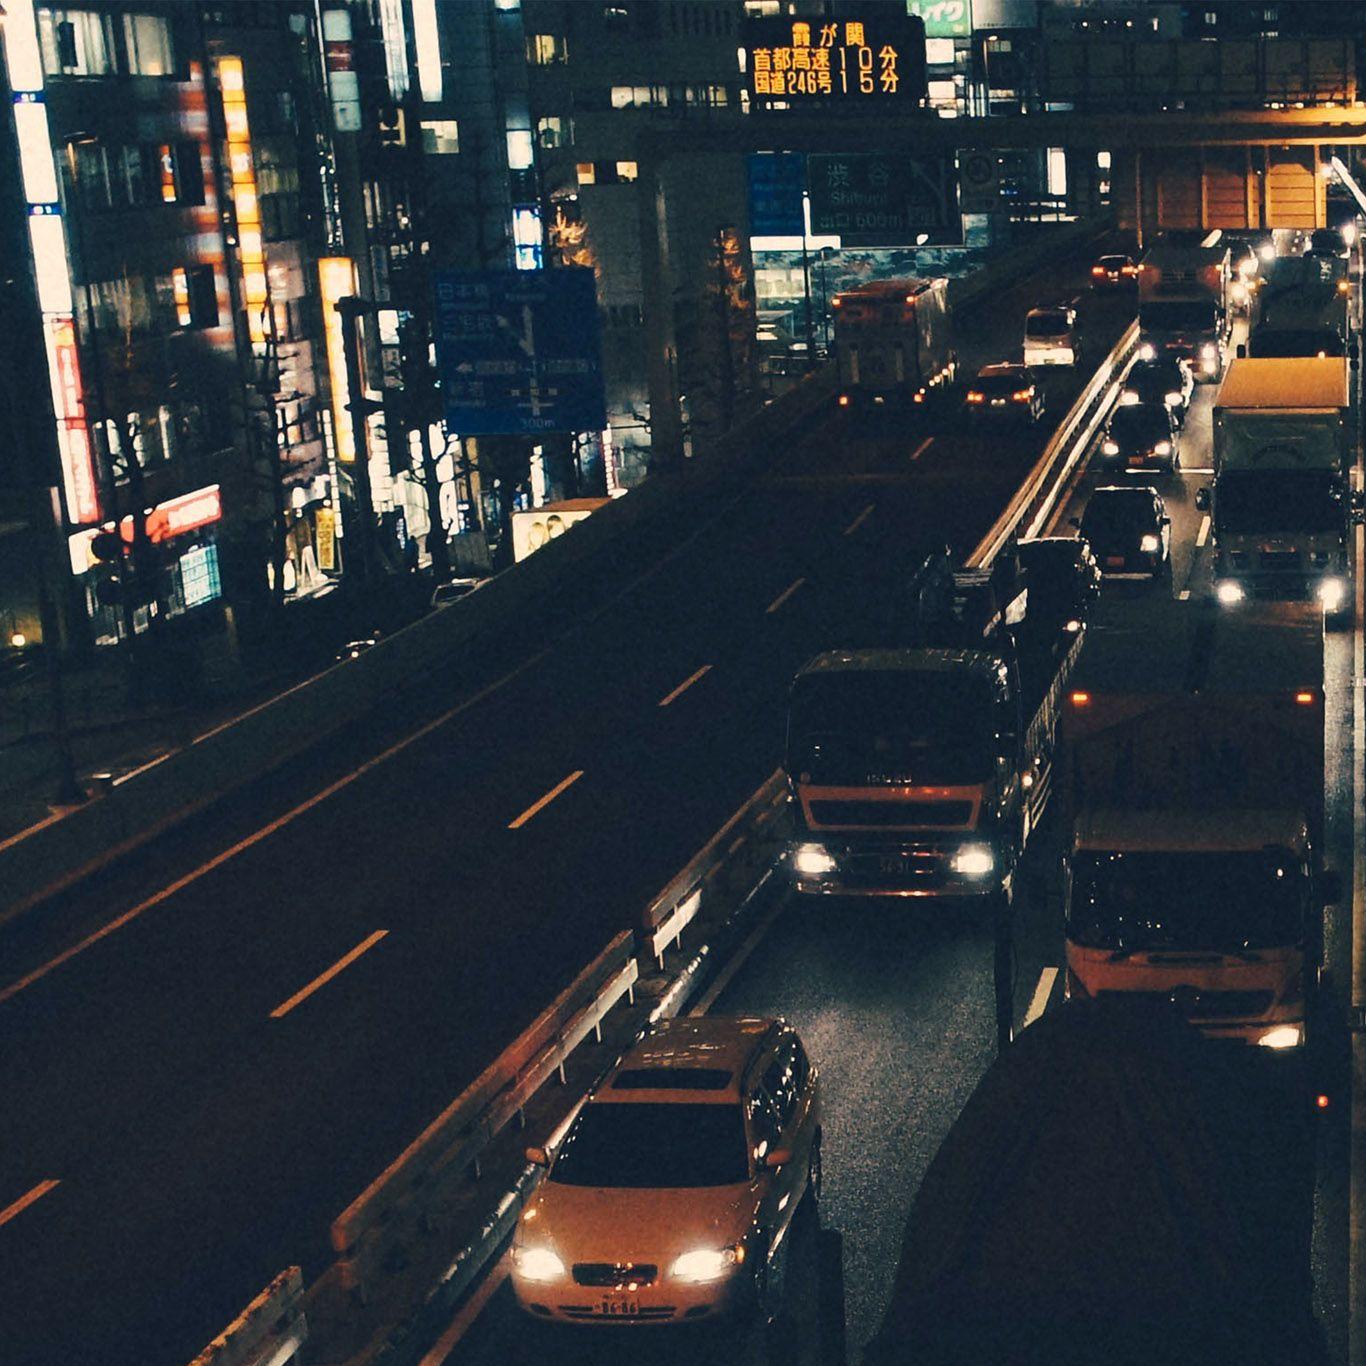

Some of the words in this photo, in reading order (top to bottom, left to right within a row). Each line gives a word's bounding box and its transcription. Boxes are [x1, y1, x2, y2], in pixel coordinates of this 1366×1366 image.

[791, 22, 865, 47] 霞が関
[753, 47, 831, 71] 首都高速
[754, 71, 833, 94] 国道246号
